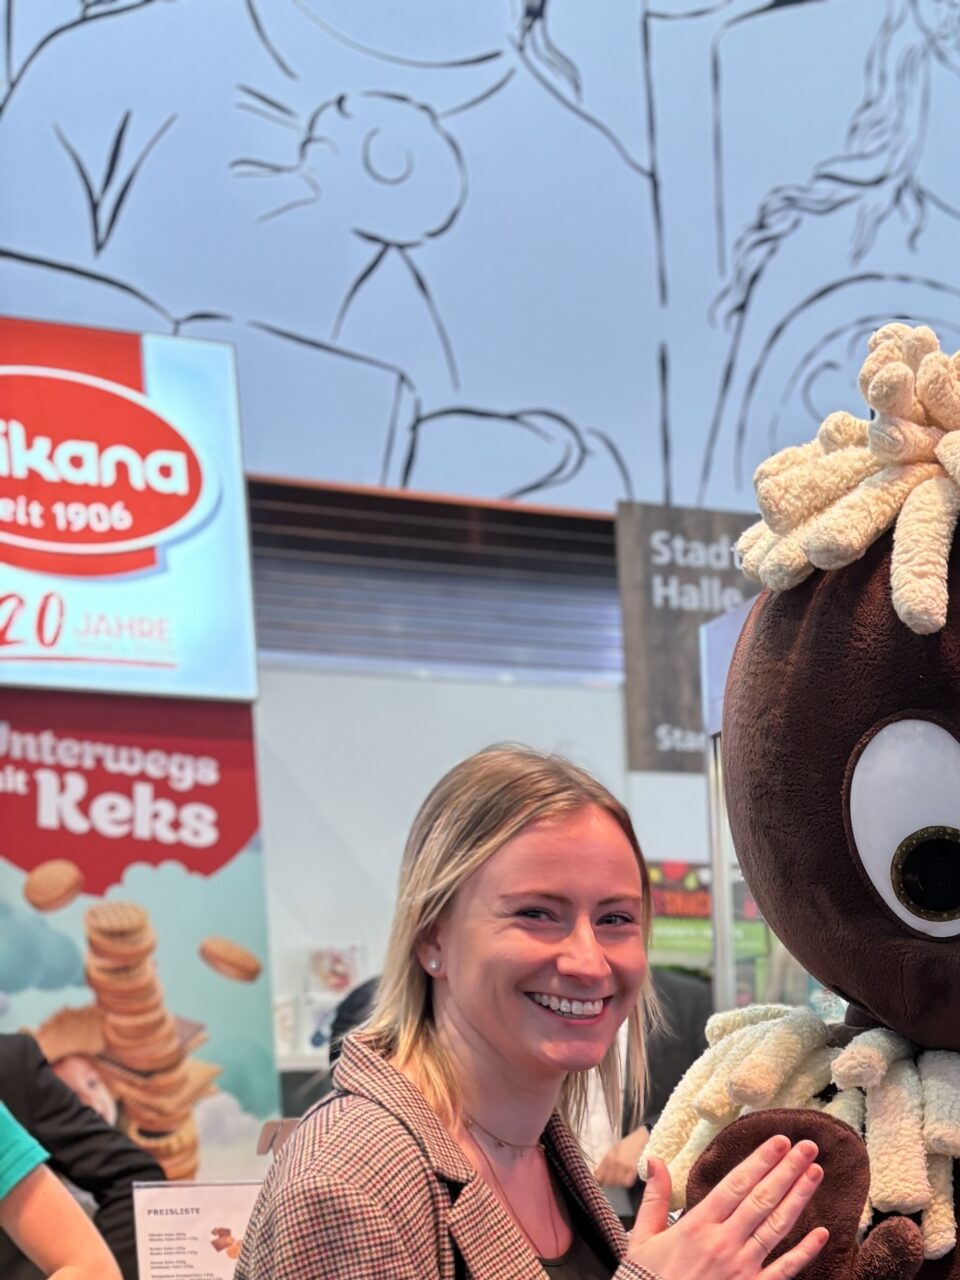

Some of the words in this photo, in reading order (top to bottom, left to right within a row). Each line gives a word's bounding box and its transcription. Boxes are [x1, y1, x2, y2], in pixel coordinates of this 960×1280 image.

[0, 418, 189, 496] ikana
[0, 495, 45, 528] eit
[51, 500, 133, 533] 1906
[652, 573, 744, 612] Halle
[0, 591, 65, 647] 20
[74, 612, 171, 644] JAHRE
[0, 765, 29, 795] it
[34, 768, 219, 848] Keks
[147, 1207, 201, 1216] PREISLISTE
